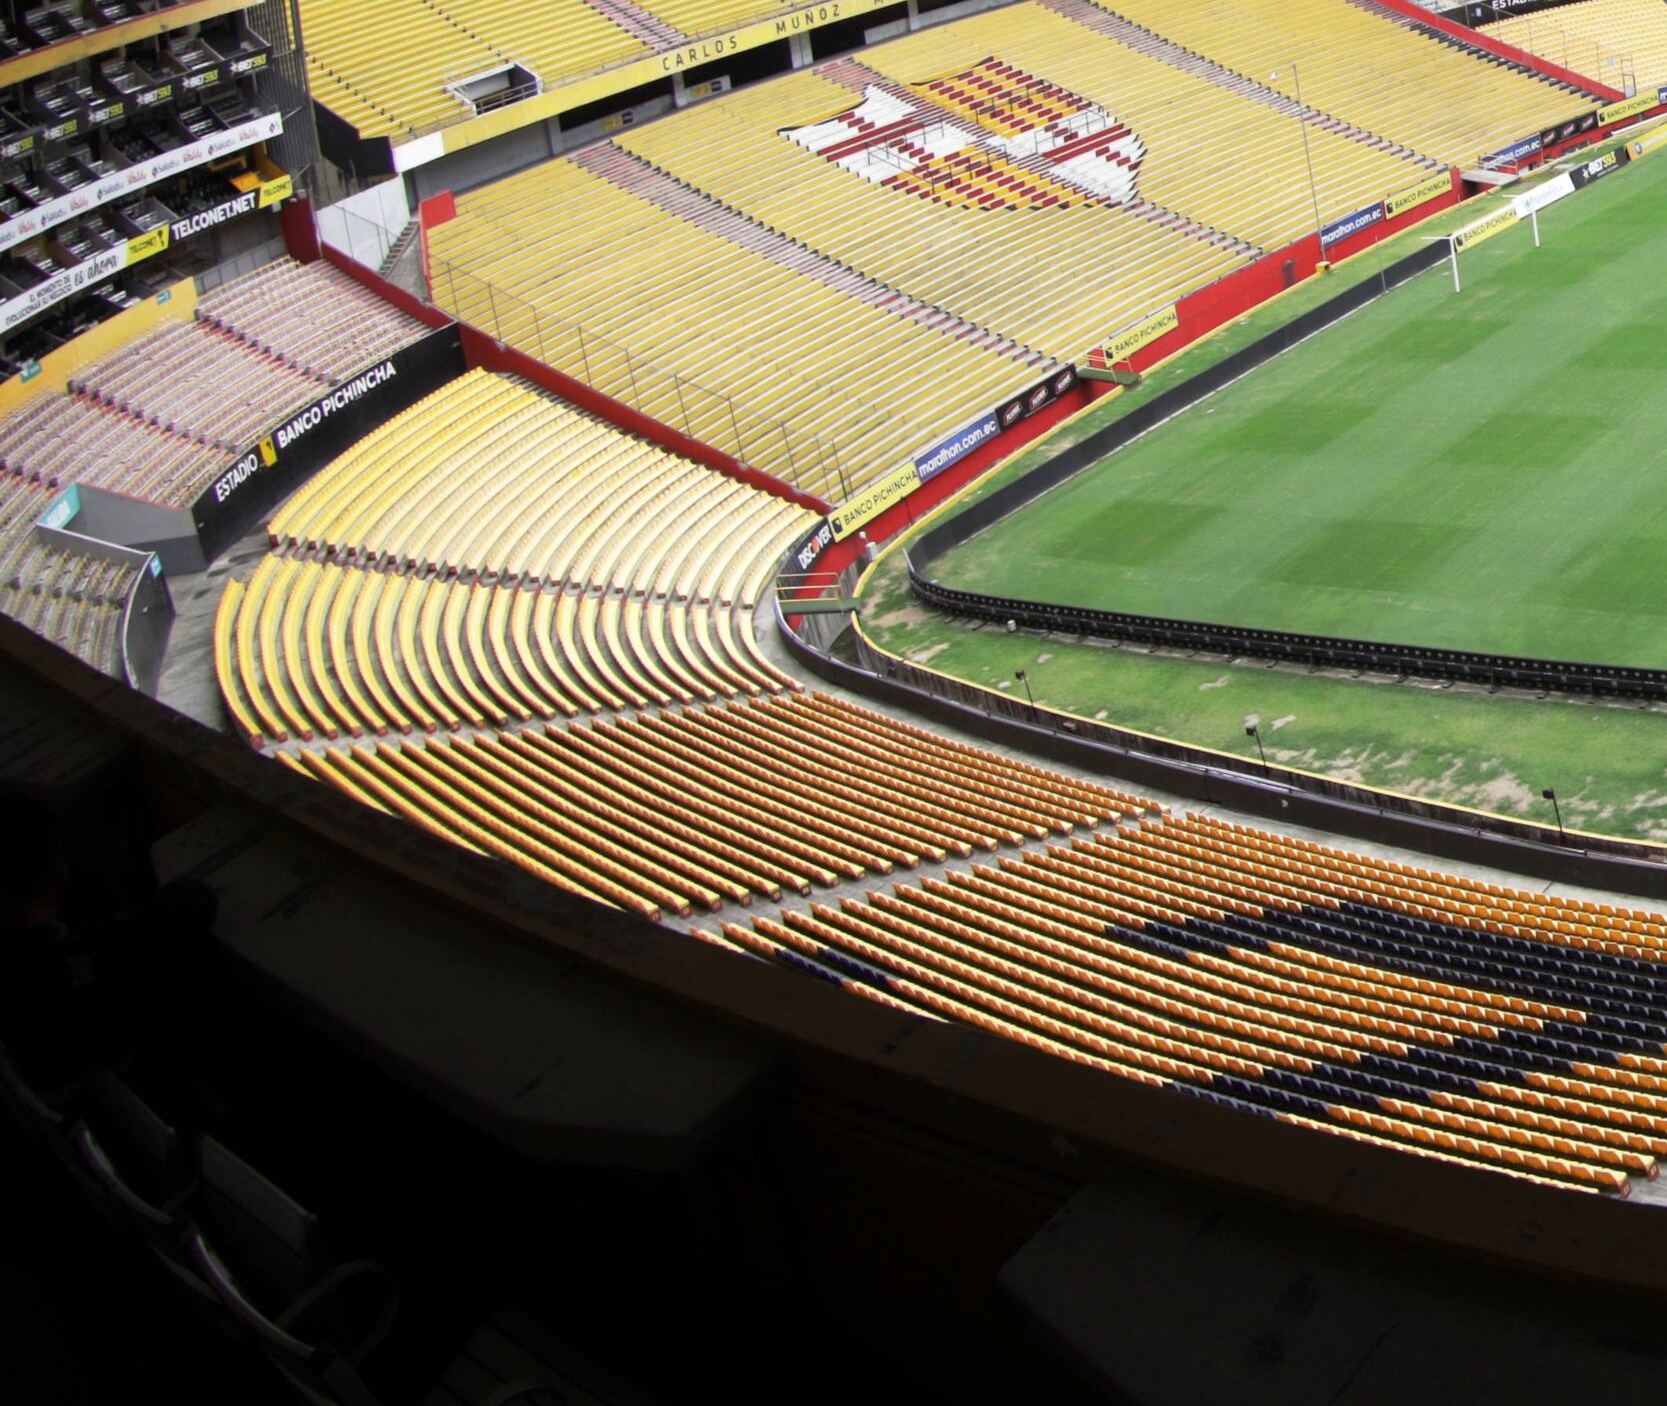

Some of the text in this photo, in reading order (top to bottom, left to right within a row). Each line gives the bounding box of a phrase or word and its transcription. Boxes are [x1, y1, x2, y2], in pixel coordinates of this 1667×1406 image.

[662, 35, 739, 71] CARLOS
[775, 3, 841, 35] MUÑOZ
[1587, 150, 1616, 172] BET593
[172, 192, 256, 240] TELCONET.NET
[1321, 208, 1382, 245] marathon.com.ec
[87, 252, 118, 281] ahora
[1139, 312, 1177, 338] PICHINCHA
[214, 361, 397, 502] ESTADIO BANCO PICHINCHA
[918, 418, 997, 479] marathon.com.ec
[843, 469, 918, 526] BANCO PICHINCHA
